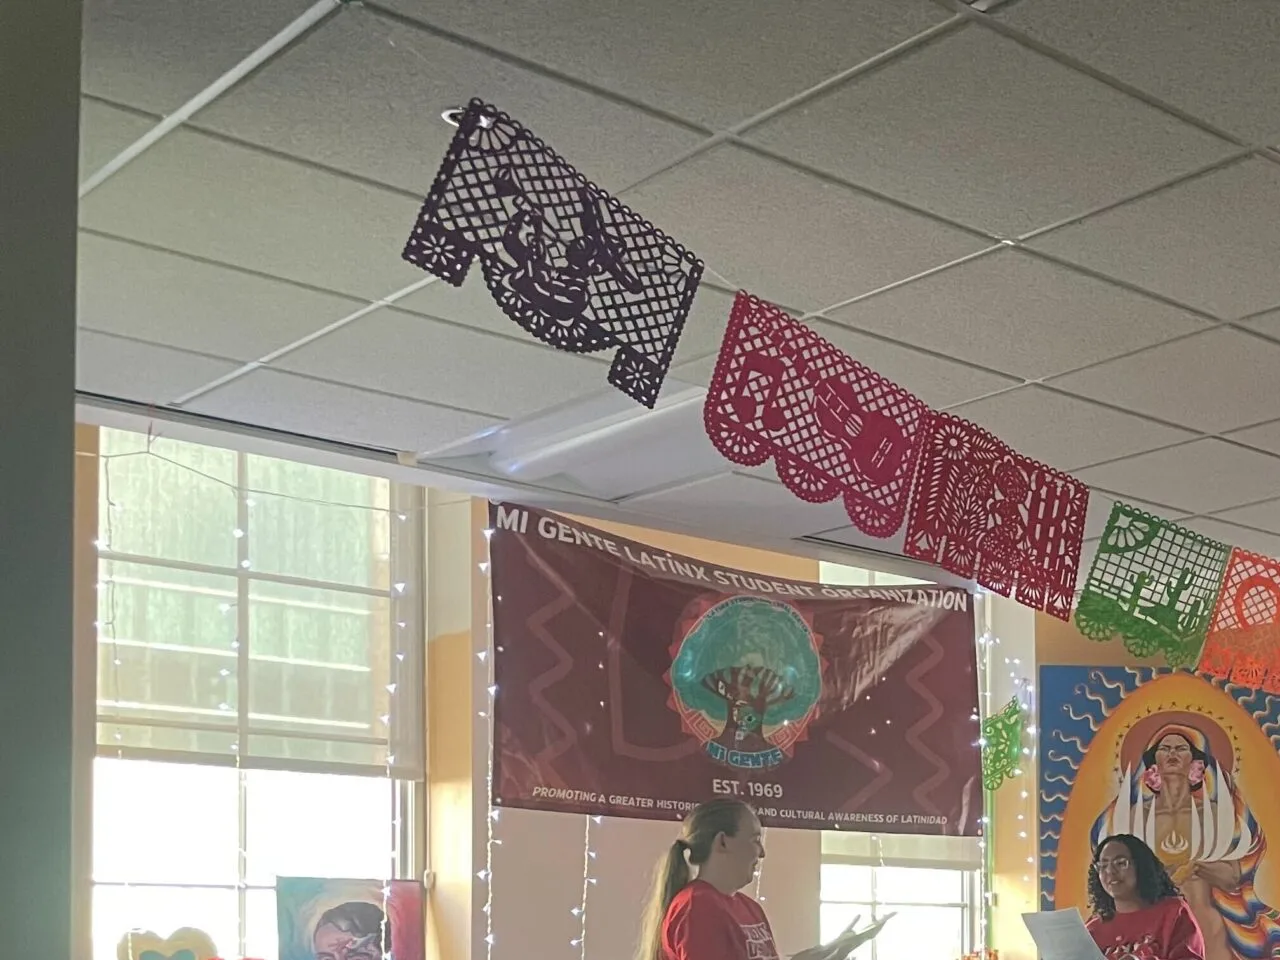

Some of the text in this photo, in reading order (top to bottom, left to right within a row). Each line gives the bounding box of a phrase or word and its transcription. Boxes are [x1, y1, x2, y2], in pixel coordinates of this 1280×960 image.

[496, 506, 529, 534] MI
[537, 516, 622, 557] GENTE
[716, 570, 820, 597] STUDENT
[823, 585, 968, 613] ORGANIZATION
[532, 786, 596, 802] PROMOTING
[597, 794, 606, 804] A
[609, 794, 653, 809] GREATER
[758, 807, 777, 817] AND
[779, 809, 825, 820] CULTURAL
[828, 812, 884, 823] AWARENESS
[886, 814, 898, 824] OF
[901, 814, 947, 825] LATINIDAD
[713, 779, 783, 798] EST. 1969
